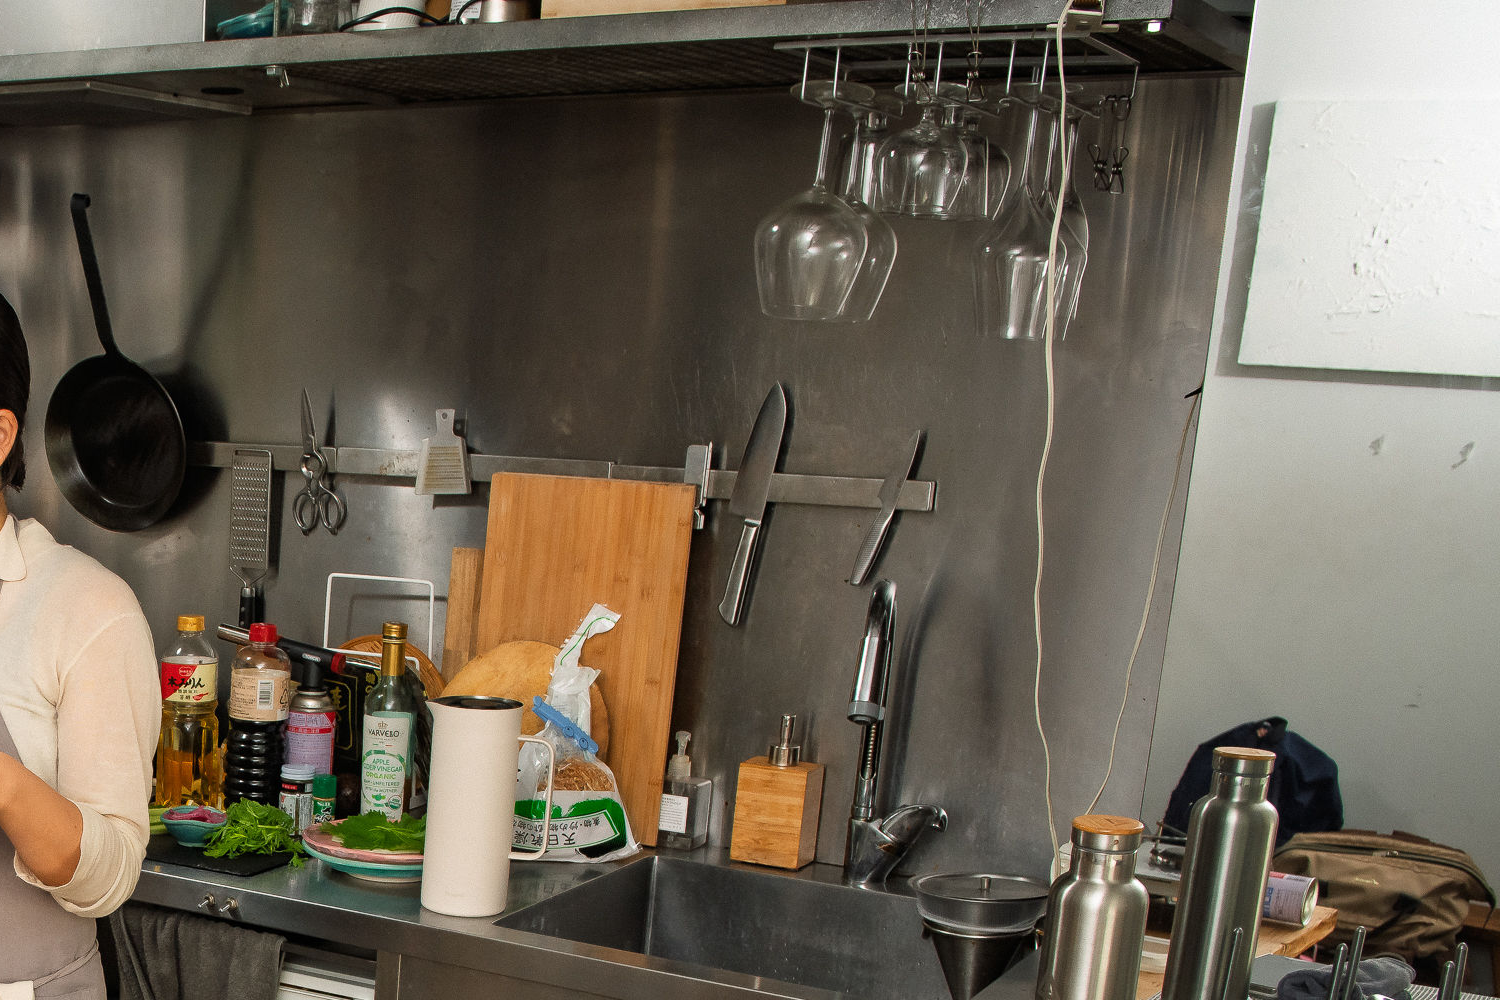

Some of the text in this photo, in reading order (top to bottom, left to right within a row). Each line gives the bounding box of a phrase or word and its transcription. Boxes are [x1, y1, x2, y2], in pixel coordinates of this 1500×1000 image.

[167, 676, 206, 689] 本みりん
[372, 758, 390, 766] APPLE
[377, 765, 403, 773] VINEGAR
[365, 771, 397, 780] ORGANIC
